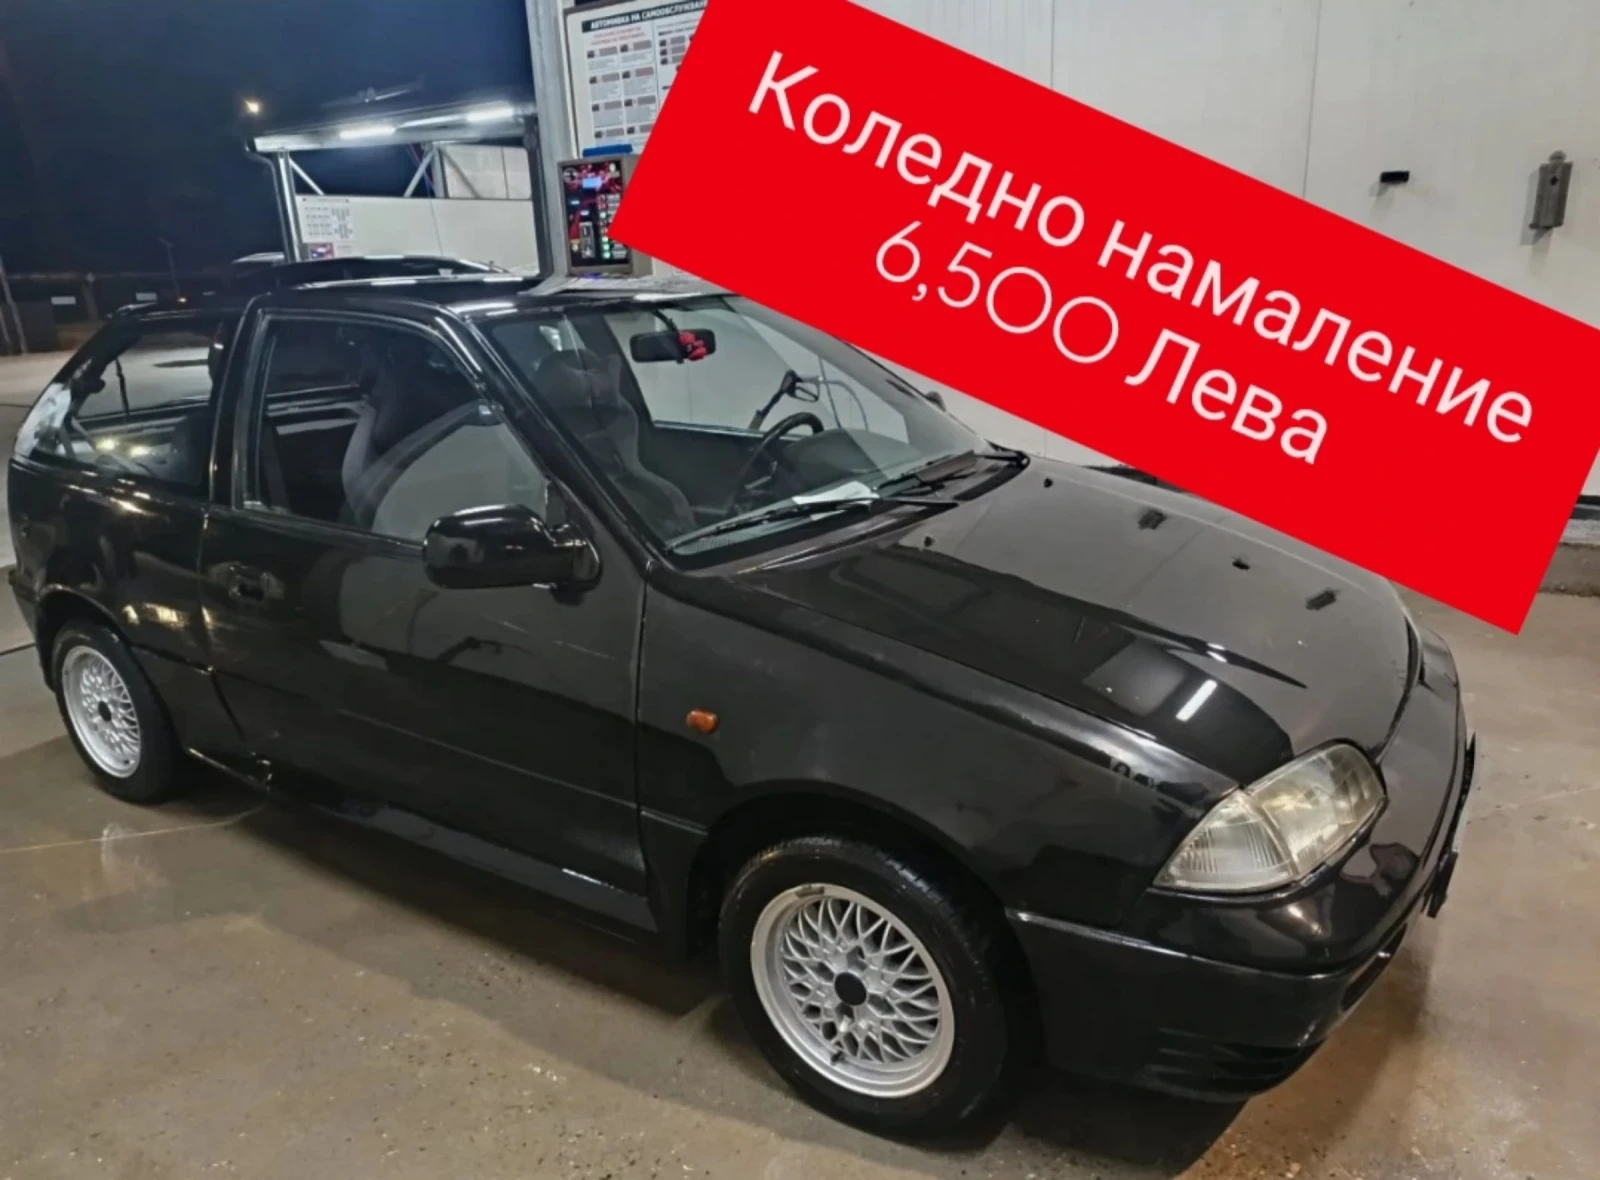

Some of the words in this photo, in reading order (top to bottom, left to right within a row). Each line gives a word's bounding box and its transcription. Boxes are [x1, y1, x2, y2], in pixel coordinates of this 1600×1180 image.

[590, 15, 630, 29] АВТОМИВКА
[631, 12, 641, 22] НА
[641, 1, 706, 19] САМООБСЛУЖВАН
